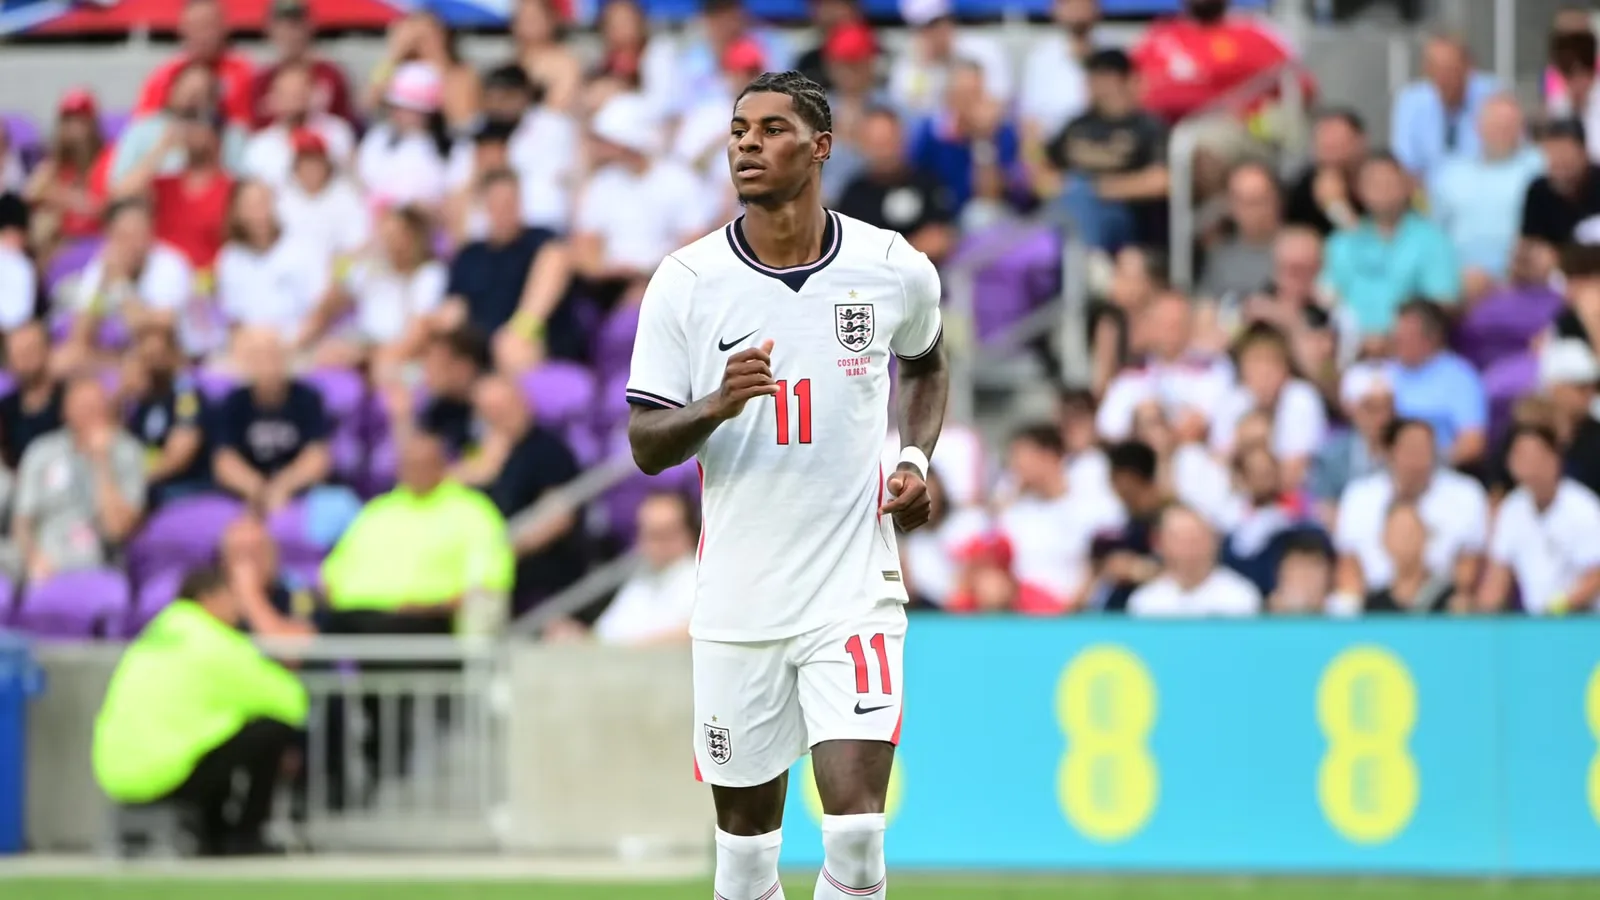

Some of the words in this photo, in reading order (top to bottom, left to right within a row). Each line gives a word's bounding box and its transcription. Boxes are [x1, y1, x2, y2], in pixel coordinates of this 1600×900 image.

[837, 358, 859, 367] COSTA
[770, 378, 812, 445] 11
[844, 632, 892, 695] 11
